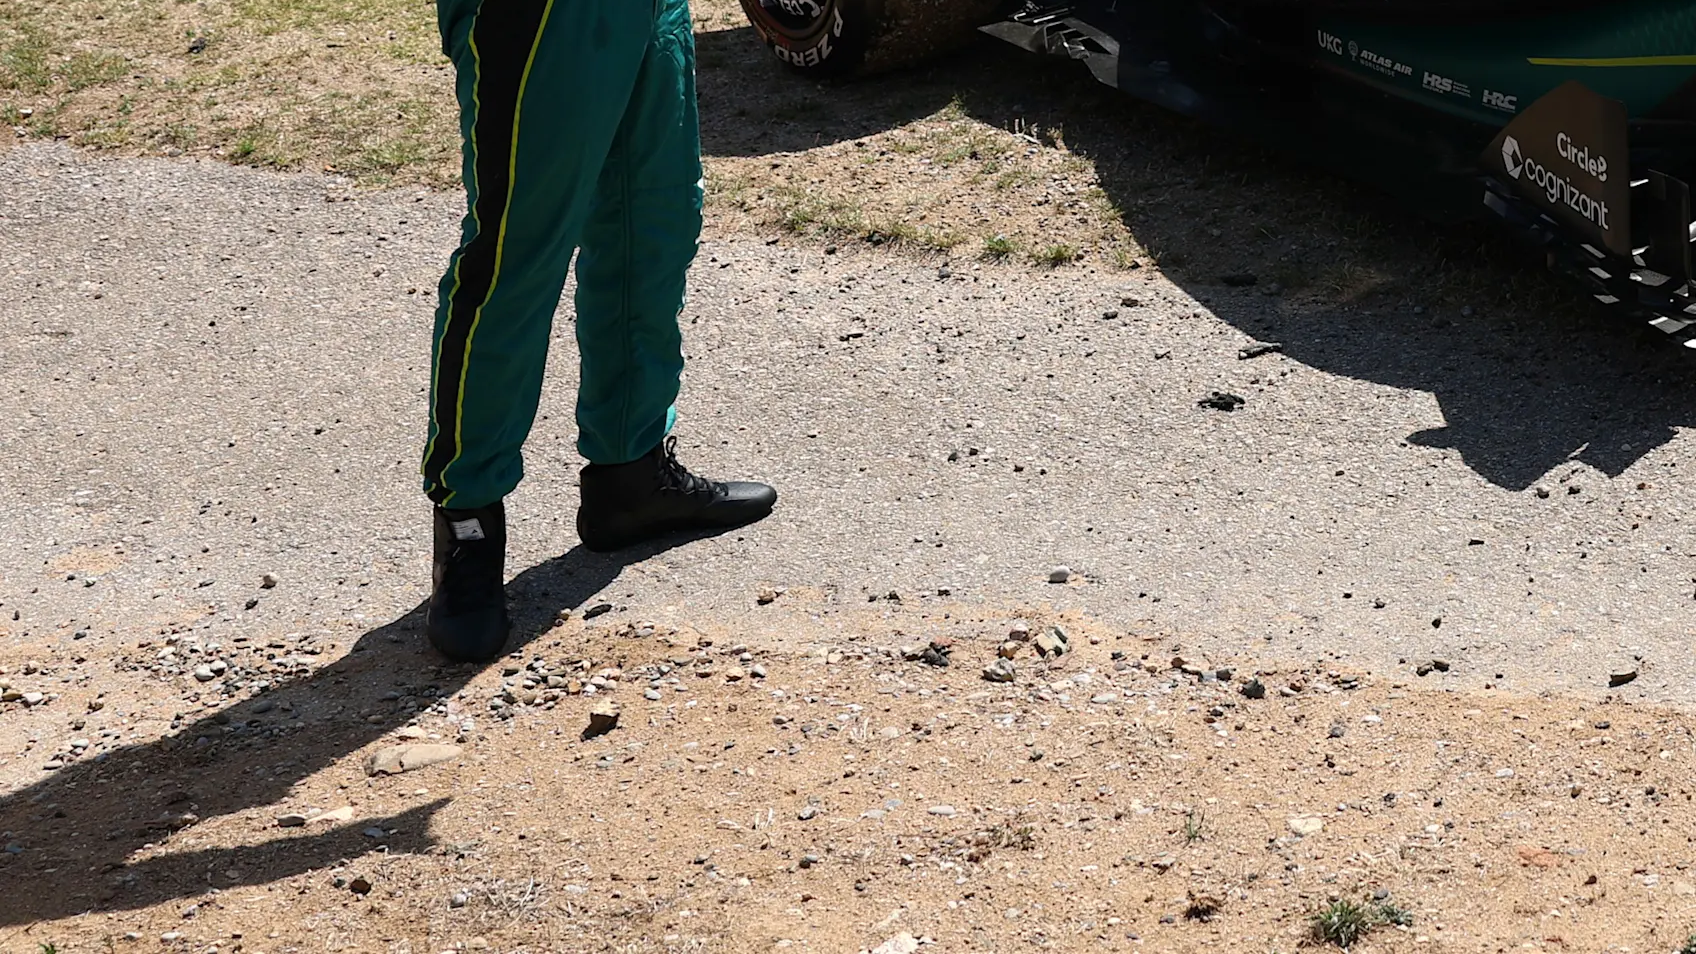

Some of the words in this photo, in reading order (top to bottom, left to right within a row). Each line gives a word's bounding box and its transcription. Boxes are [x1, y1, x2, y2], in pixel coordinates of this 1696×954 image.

[832, 5, 844, 38] P
[774, 32, 833, 67] ZERO
[1316, 29, 1343, 56] UKG
[1360, 49, 1393, 68] ATLAS
[1393, 62, 1413, 77] AIR
[1422, 71, 1453, 93] HRS
[1482, 89, 1518, 111] HRC
[1524, 157, 1609, 230] cognizant
